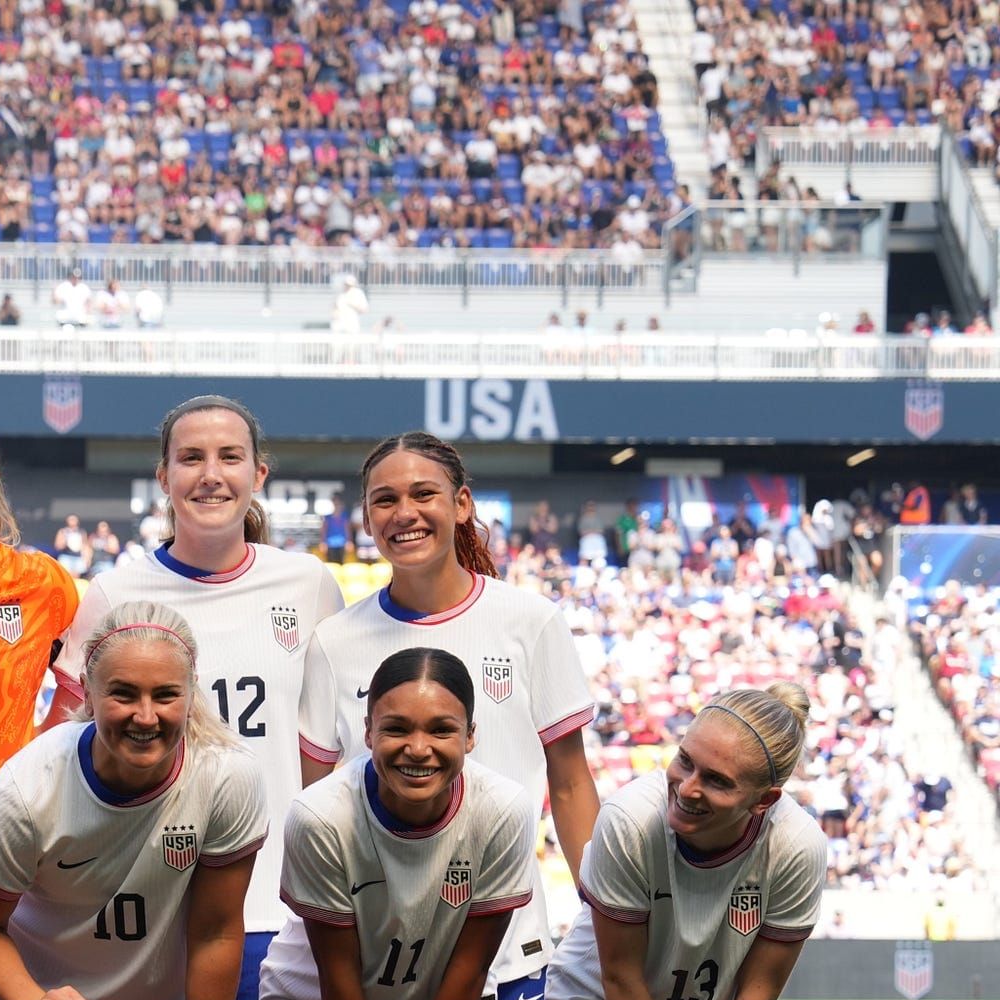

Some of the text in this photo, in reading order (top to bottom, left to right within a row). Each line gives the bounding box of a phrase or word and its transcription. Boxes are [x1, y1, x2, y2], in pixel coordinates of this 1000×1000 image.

[425, 380, 559, 441] USA
[274, 616, 296, 630] USA
[485, 666, 510, 681] USA
[211, 676, 266, 737] 12
[166, 836, 194, 851] USA
[94, 893, 147, 941] 10
[731, 896, 759, 911] USA
[377, 938, 425, 986] 11
